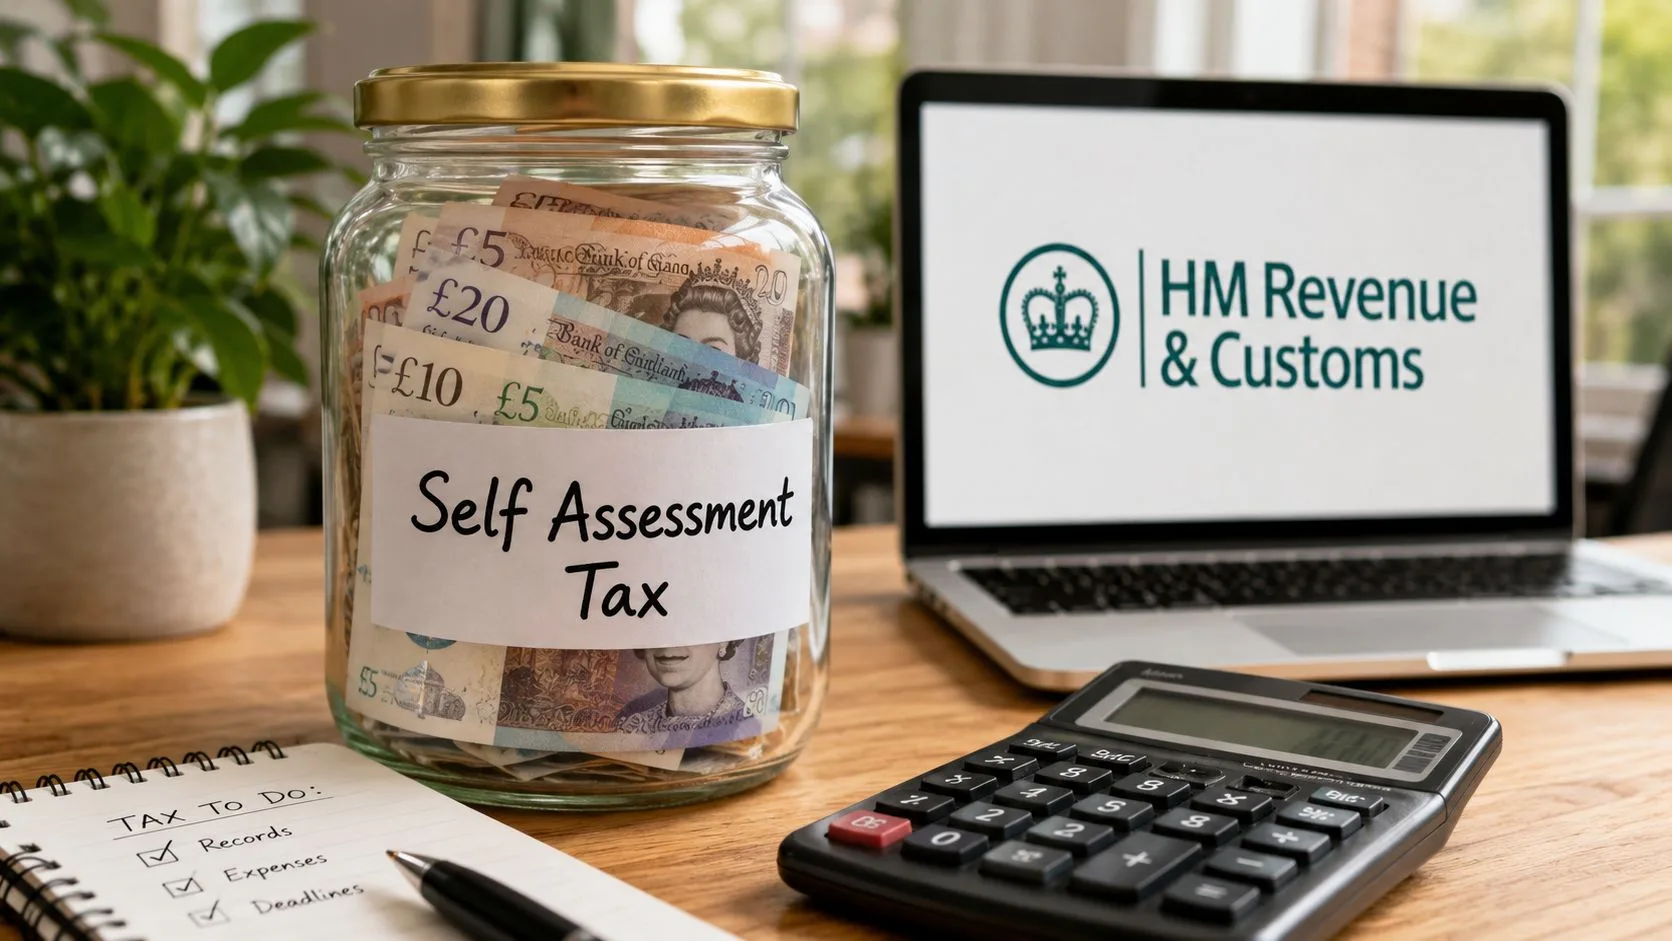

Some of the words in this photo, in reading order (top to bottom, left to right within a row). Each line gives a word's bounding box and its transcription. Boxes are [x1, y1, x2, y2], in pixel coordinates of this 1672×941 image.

[427, 278, 510, 334] £20
[1161, 259, 1248, 317] HM
[1265, 262, 1477, 322] Revenue
[1161, 330, 1198, 387] &
[1211, 331, 1424, 390] Customs
[391, 356, 463, 407] £10
[494, 381, 545, 423] £5
[411, 469, 533, 552] Self
[547, 476, 795, 543] Assessment
[565, 560, 669, 620] Tax
[106, 809, 186, 833] TAX
[975, 808, 1005, 822] 2
[1053, 822, 1085, 838] 2
[198, 825, 293, 853] Records
[224, 853, 328, 884] Expenses
[251, 882, 365, 915] Deadlines
